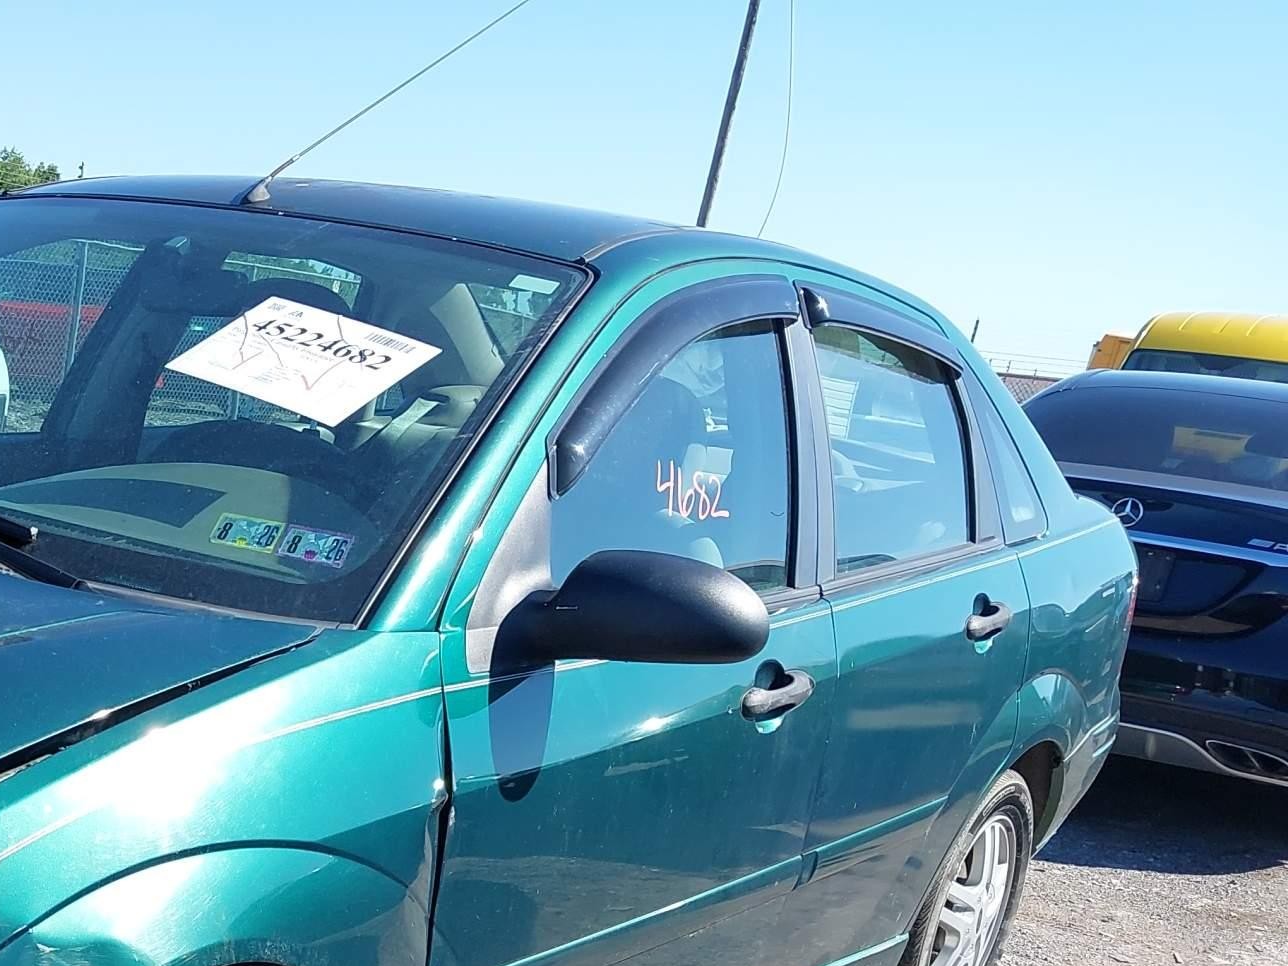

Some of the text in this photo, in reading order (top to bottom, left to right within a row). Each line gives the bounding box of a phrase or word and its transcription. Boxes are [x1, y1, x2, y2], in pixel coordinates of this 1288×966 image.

[252, 319, 392, 371] 45224682
[656, 459, 730, 520] 4682
[218, 522, 279, 547] 8 26
[287, 535, 348, 560] 8 26
